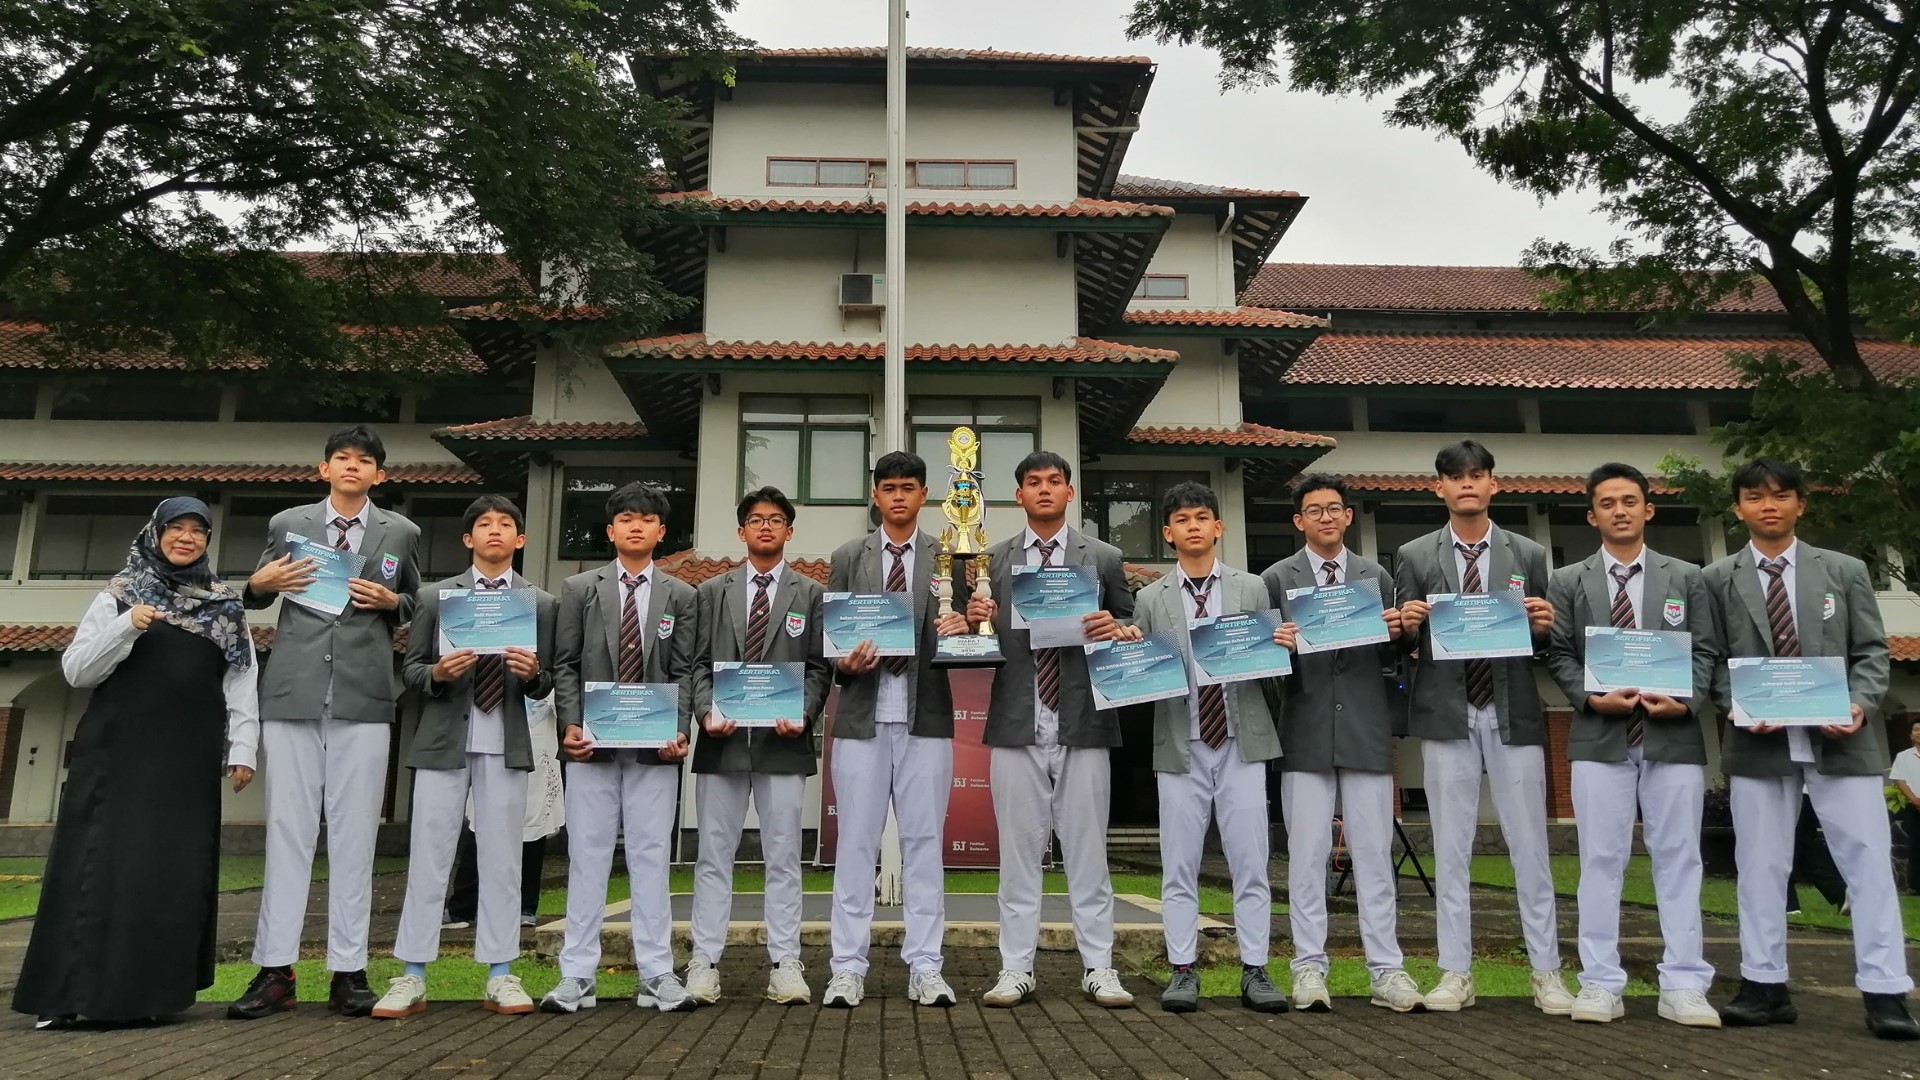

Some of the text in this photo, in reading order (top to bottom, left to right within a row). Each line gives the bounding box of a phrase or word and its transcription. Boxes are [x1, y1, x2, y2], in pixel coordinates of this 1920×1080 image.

[301, 544, 340, 561] SERTIFIKAT
[1313, 587, 1356, 600] SERTIFIKAT
[466, 595, 511, 603] SERTIFIKAT
[1454, 598, 1499, 607] SERTIFIKAT
[1214, 618, 1258, 630] SERTIFIKAT
[1614, 635, 1663, 643] SERTIFIKAT
[1110, 641, 1154, 654] SERTIFIKAT
[1155, 654, 1174, 662] SCHOOL
